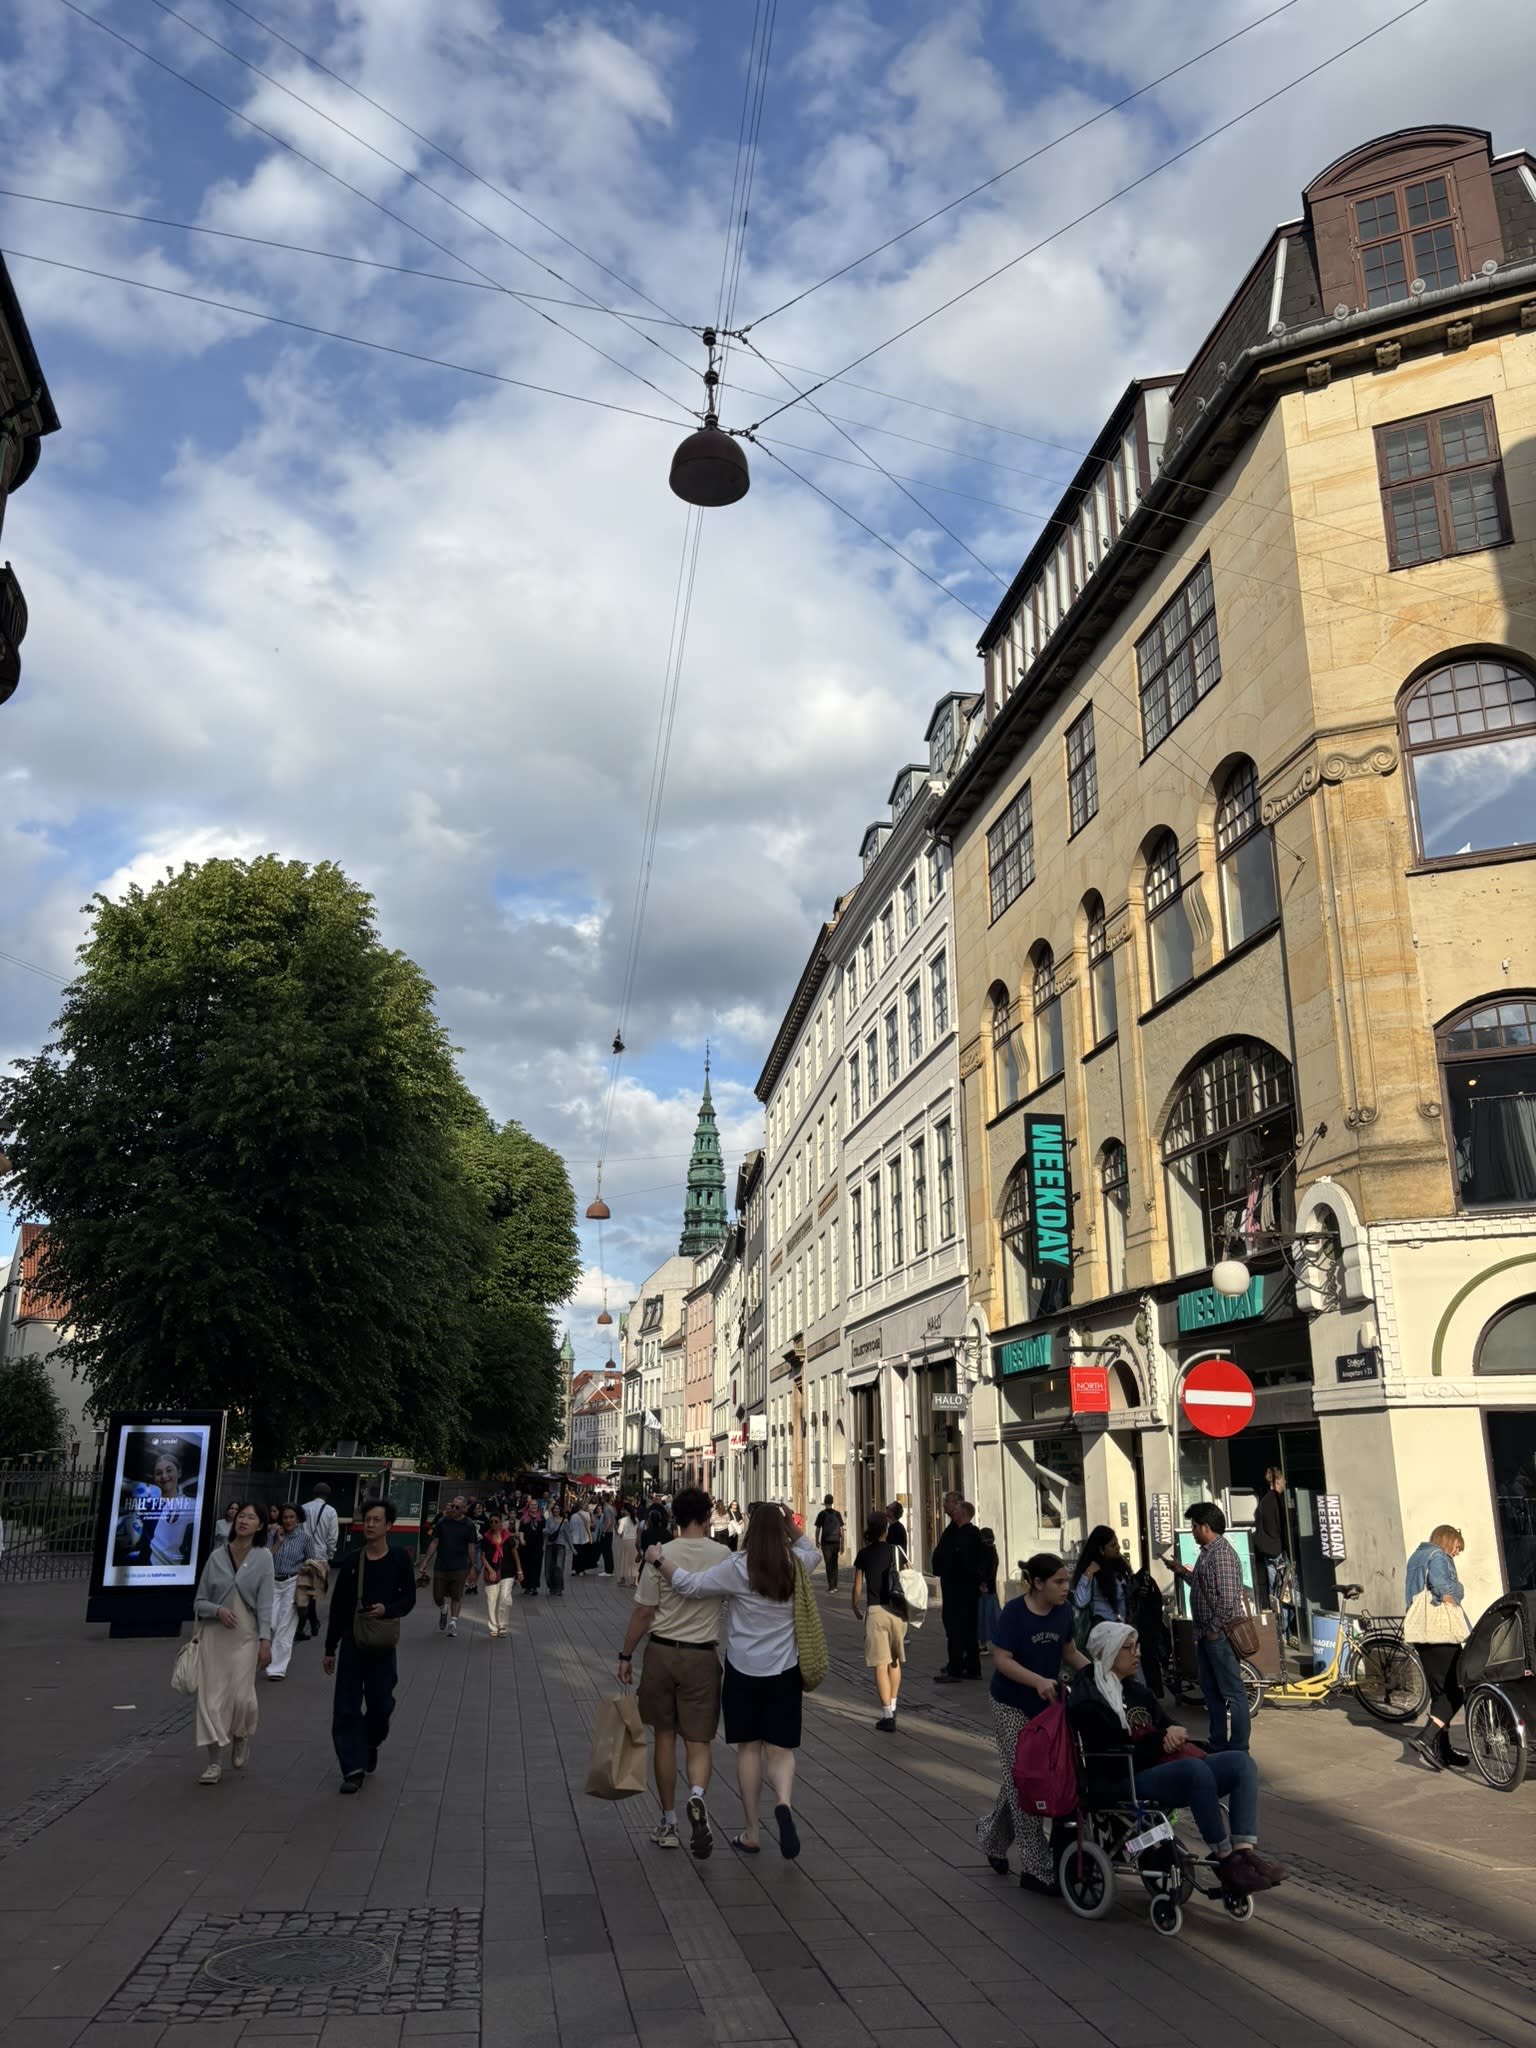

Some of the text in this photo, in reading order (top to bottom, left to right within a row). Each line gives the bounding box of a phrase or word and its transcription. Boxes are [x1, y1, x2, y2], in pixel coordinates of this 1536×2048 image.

[1032, 1124, 1070, 1265] WEEKDAY
[1177, 1275, 1264, 1332] WEEKDAY
[1002, 1334, 1052, 1375] WEEKDAY
[934, 1396, 962, 1405] HALO
[1159, 1494, 1172, 1544] WEEKDAY
[1317, 1495, 1330, 1558] WEEKDAY
[1326, 1495, 1346, 1558] WEEKDAY
